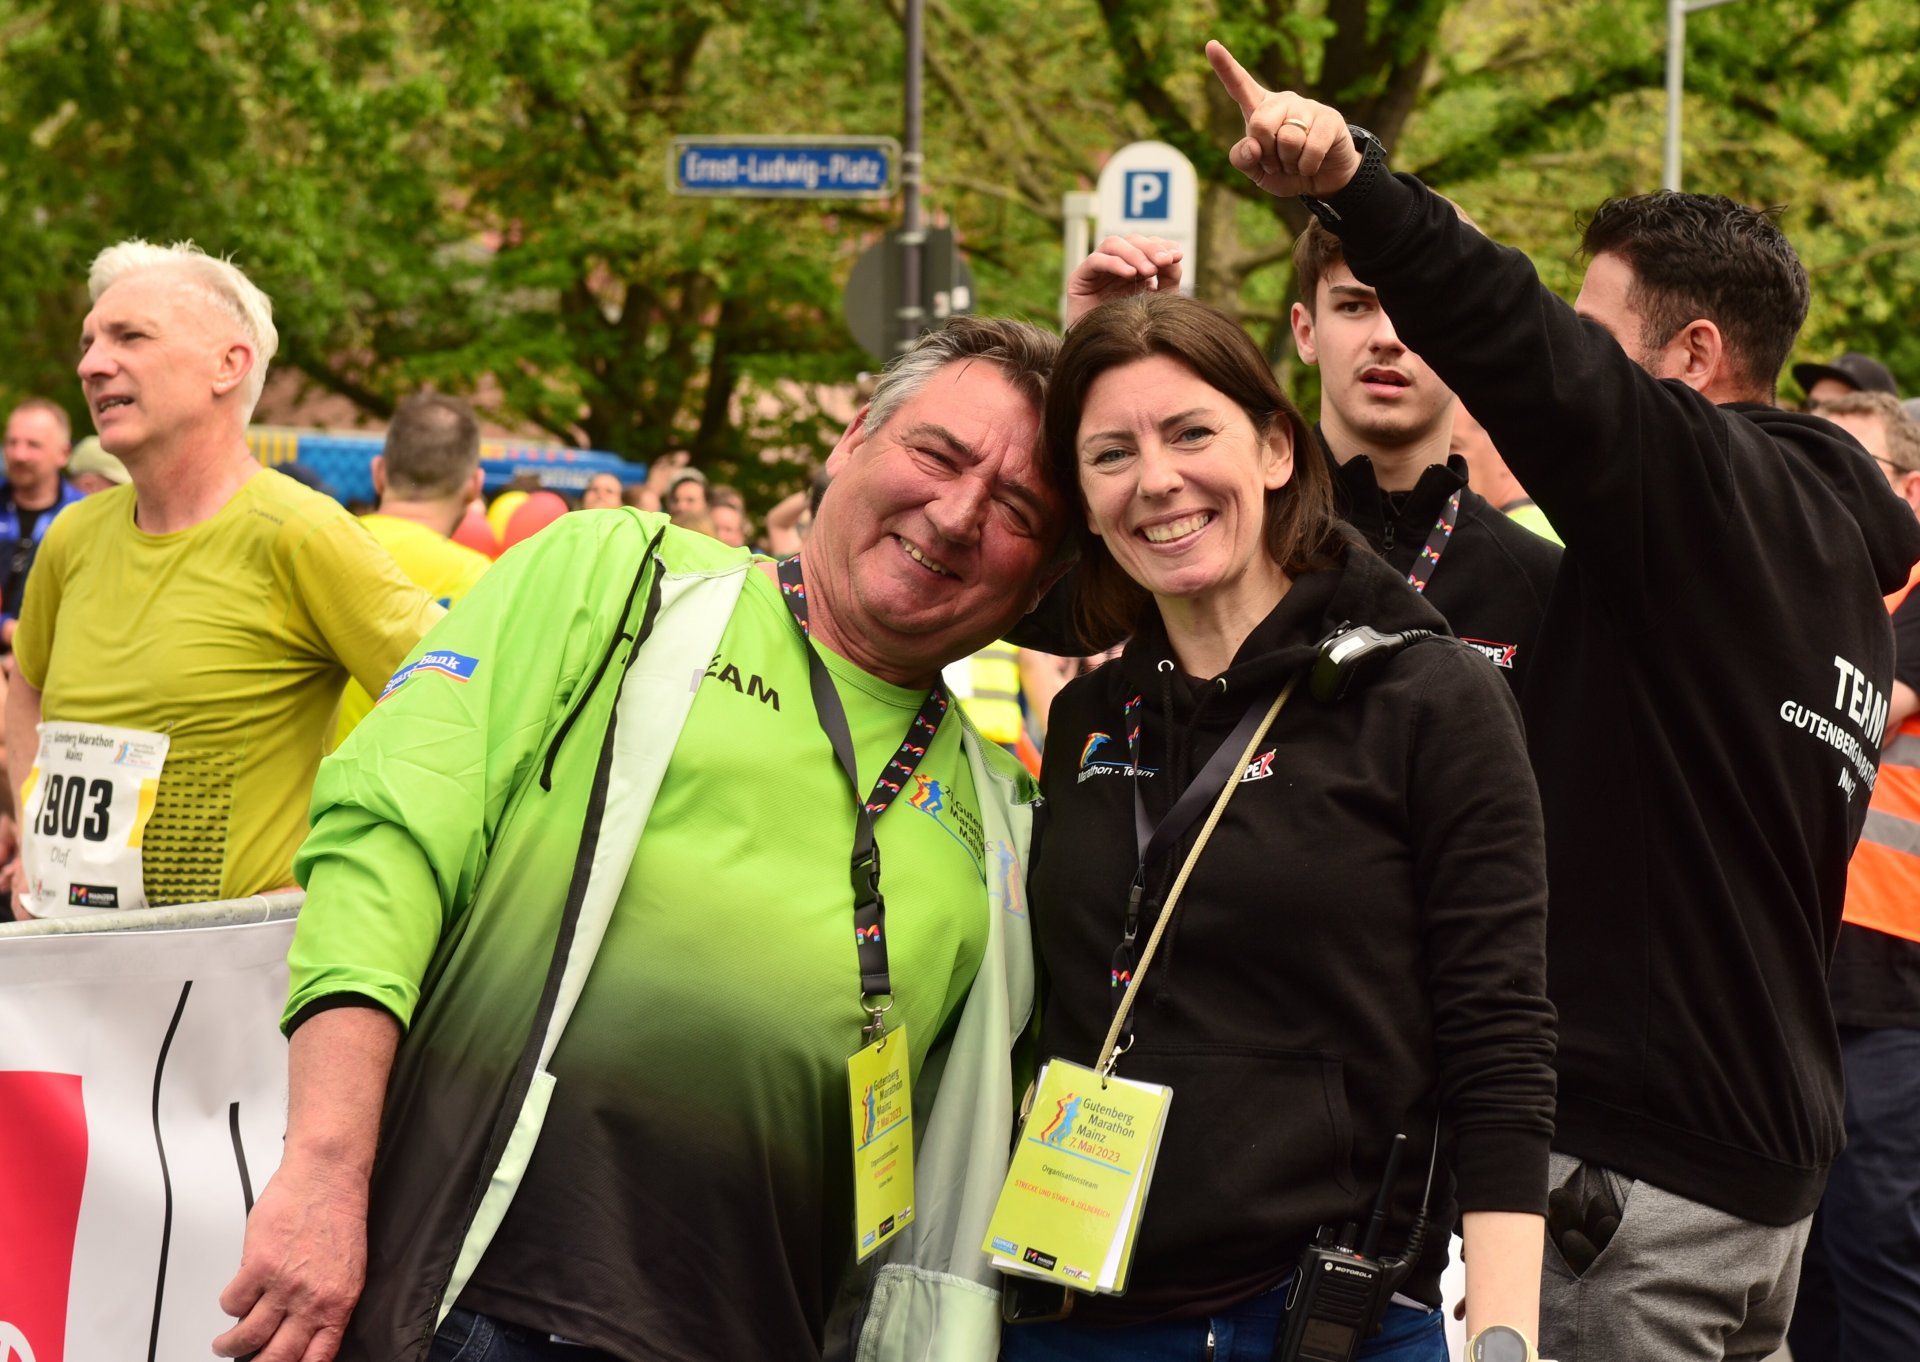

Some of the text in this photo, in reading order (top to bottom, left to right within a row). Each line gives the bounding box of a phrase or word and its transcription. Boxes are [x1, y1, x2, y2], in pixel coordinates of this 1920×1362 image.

[685, 151, 880, 190] Ernst-Ludwig-Platz
[1130, 173, 1163, 218] P
[703, 653, 781, 713] EAM
[1833, 654, 1889, 750] TEAM
[78, 732, 115, 749] Marathon
[1779, 700, 1860, 763] GUTENBERG
[1077, 765, 1113, 785] Marathon
[1123, 766, 1155, 778] Team
[1083, 1098, 1134, 1126] Gutenberg
[1076, 1124, 1107, 1143] Mainz
[1088, 1114, 1135, 1138] Marathon
[1069, 1136, 1121, 1163] 7. Mai 2023
[1042, 1164, 1099, 1189] Organisationsteam
[1335, 1265, 1372, 1279] MOTOROLA
